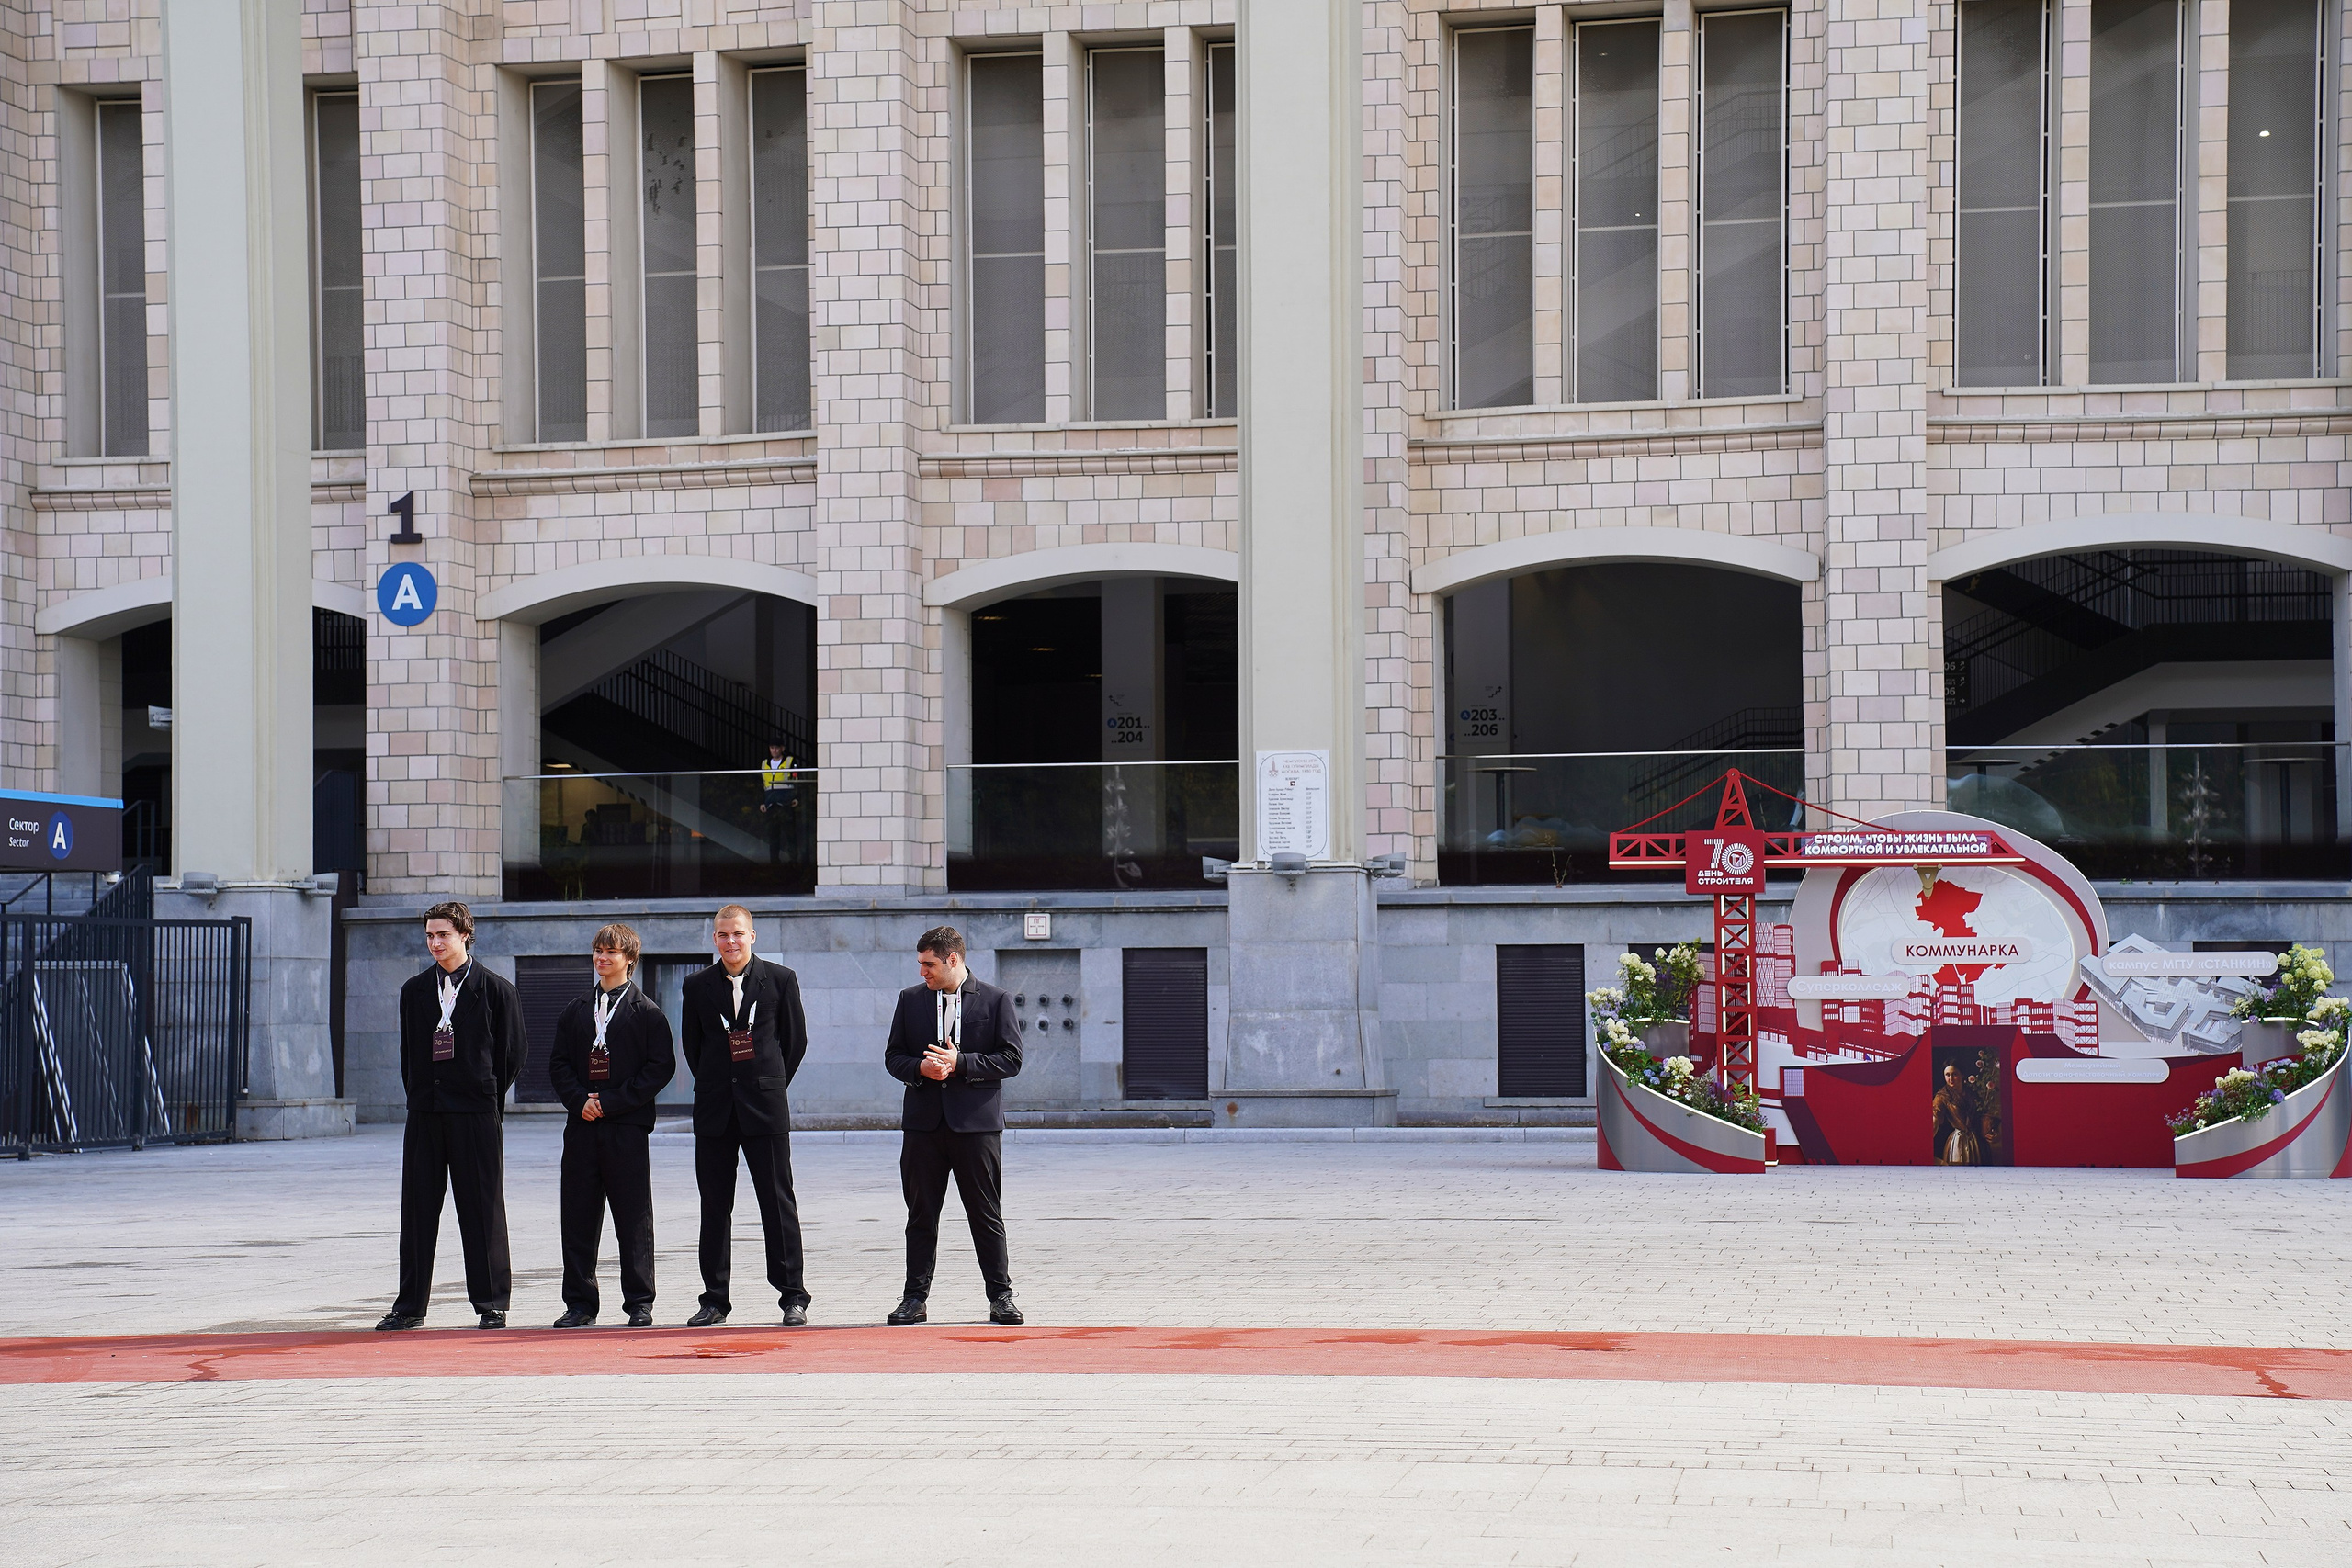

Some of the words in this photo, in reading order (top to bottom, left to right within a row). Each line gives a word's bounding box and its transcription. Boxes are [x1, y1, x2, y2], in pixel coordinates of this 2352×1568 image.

[390, 491, 422, 544] 1
[8, 818, 40, 835] Сектор
[8, 837, 30, 848] Sector
[1814, 834, 1863, 844] СТРОИМ,
[1865, 834, 1902, 843] ЧТОБЫ
[1905, 833, 1943, 843] ЖИЗНЬ
[1946, 833, 1977, 843] БЫЛА
[1804, 843, 1883, 855] КОМФОРТНОЙ
[1886, 844, 1894, 854] И
[1895, 842, 1988, 854] УВЛЕКАТЕЛЬНОЙ
[1906, 944, 2019, 957] КОММУНАРКА
[2109, 961, 2159, 972] кампус
[2163, 959, 2195, 970] МГТУ
[2198, 958, 2272, 970] «СТАНКИН»
[1796, 981, 1902, 993] Суперколледж
